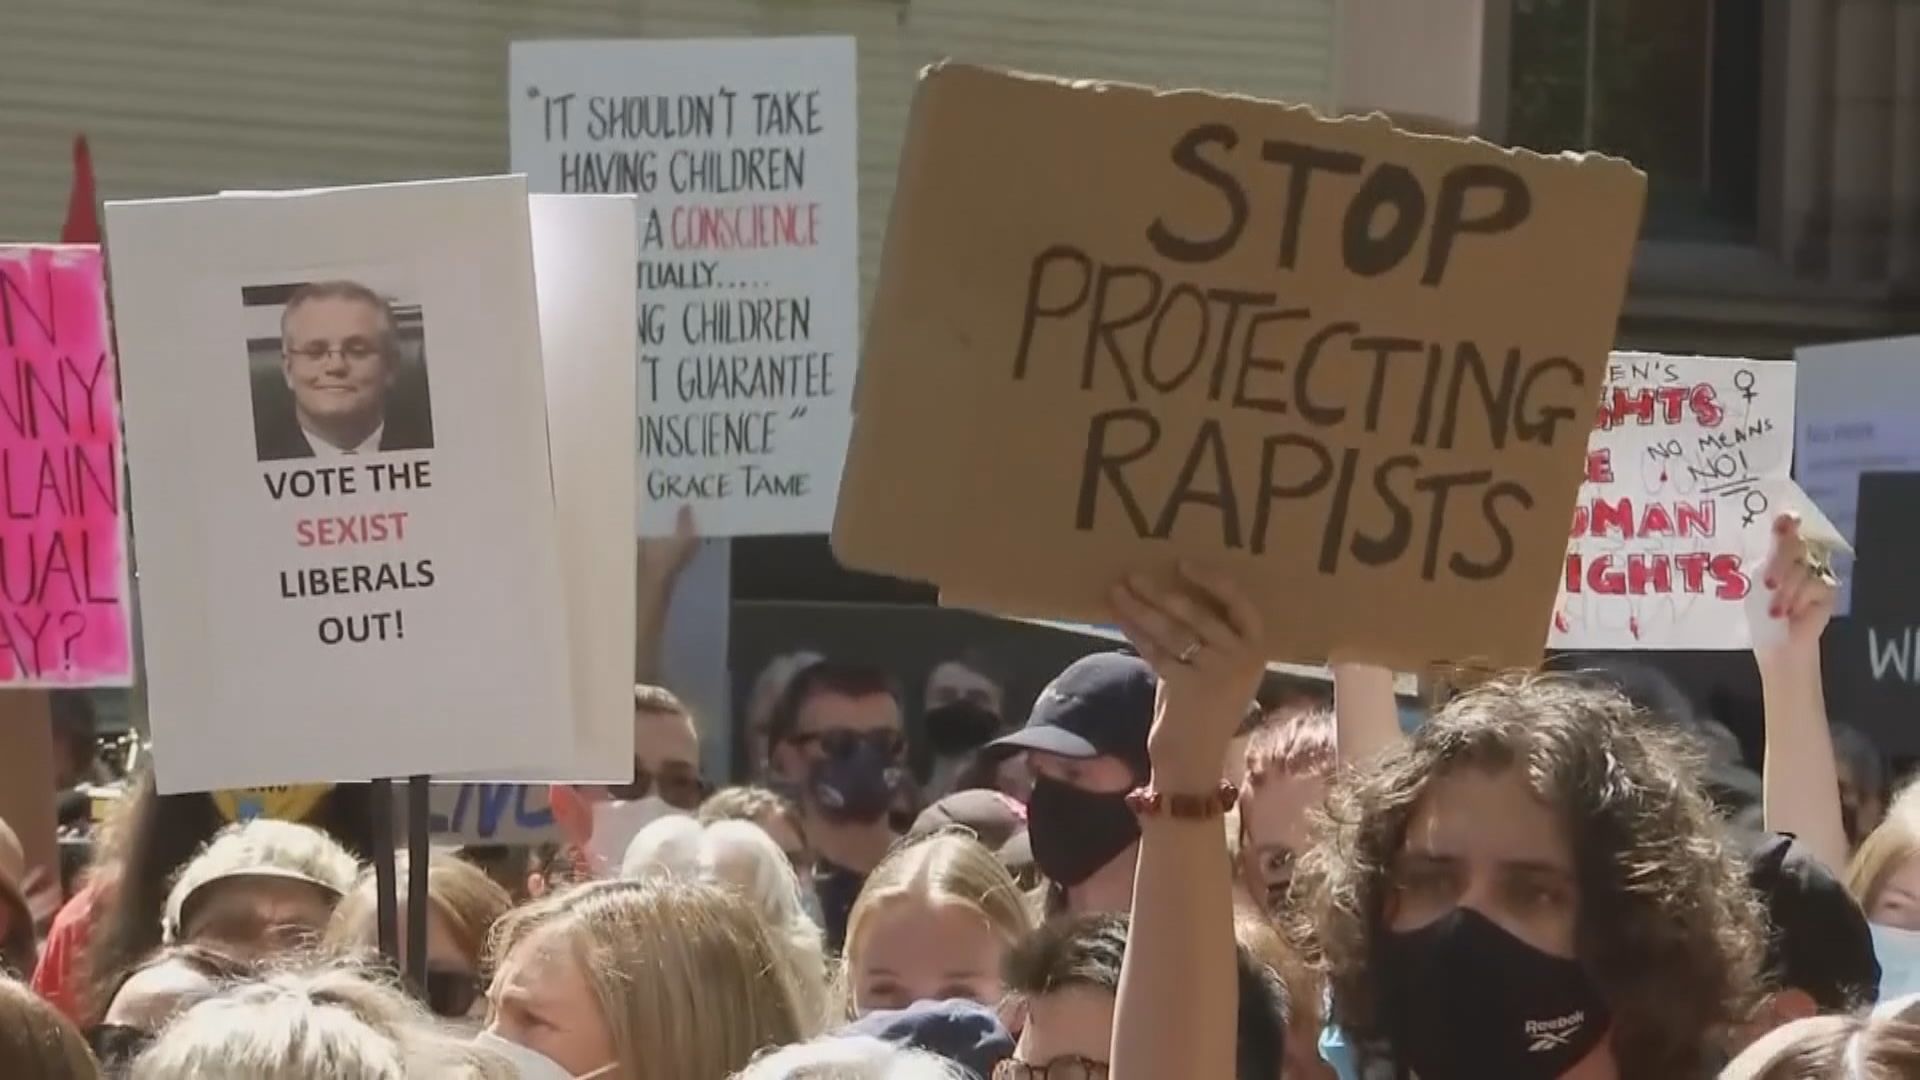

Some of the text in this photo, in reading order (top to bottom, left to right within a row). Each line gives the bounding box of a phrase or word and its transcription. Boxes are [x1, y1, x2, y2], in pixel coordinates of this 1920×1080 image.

[587, 85, 738, 140] SHOULDN'T
[752, 90, 824, 136] TAKE
[560, 147, 805, 194] HAVING CHILDREN
[643, 203, 821, 250] A CONSCIENCE
[1146, 124, 1533, 288] STOP
[683, 296, 810, 345] CHILDREN
[1013, 244, 1588, 450] PROTECTING
[677, 352, 836, 402] GUARANTEE
[1647, 439, 1682, 461] NO
[1698, 417, 1773, 453] MEANS
[263, 460, 432, 502] VOTE THE
[647, 464, 812, 500] GRACE TAME
[1688, 450, 1748, 483] NO!
[1074, 408, 1534, 582] RAPISTS
[296, 512, 409, 547] SEXIST
[279, 560, 435, 599] LIBERALS
[317, 610, 405, 645] OUT!
[1525, 1010, 1584, 1033] Reebok
